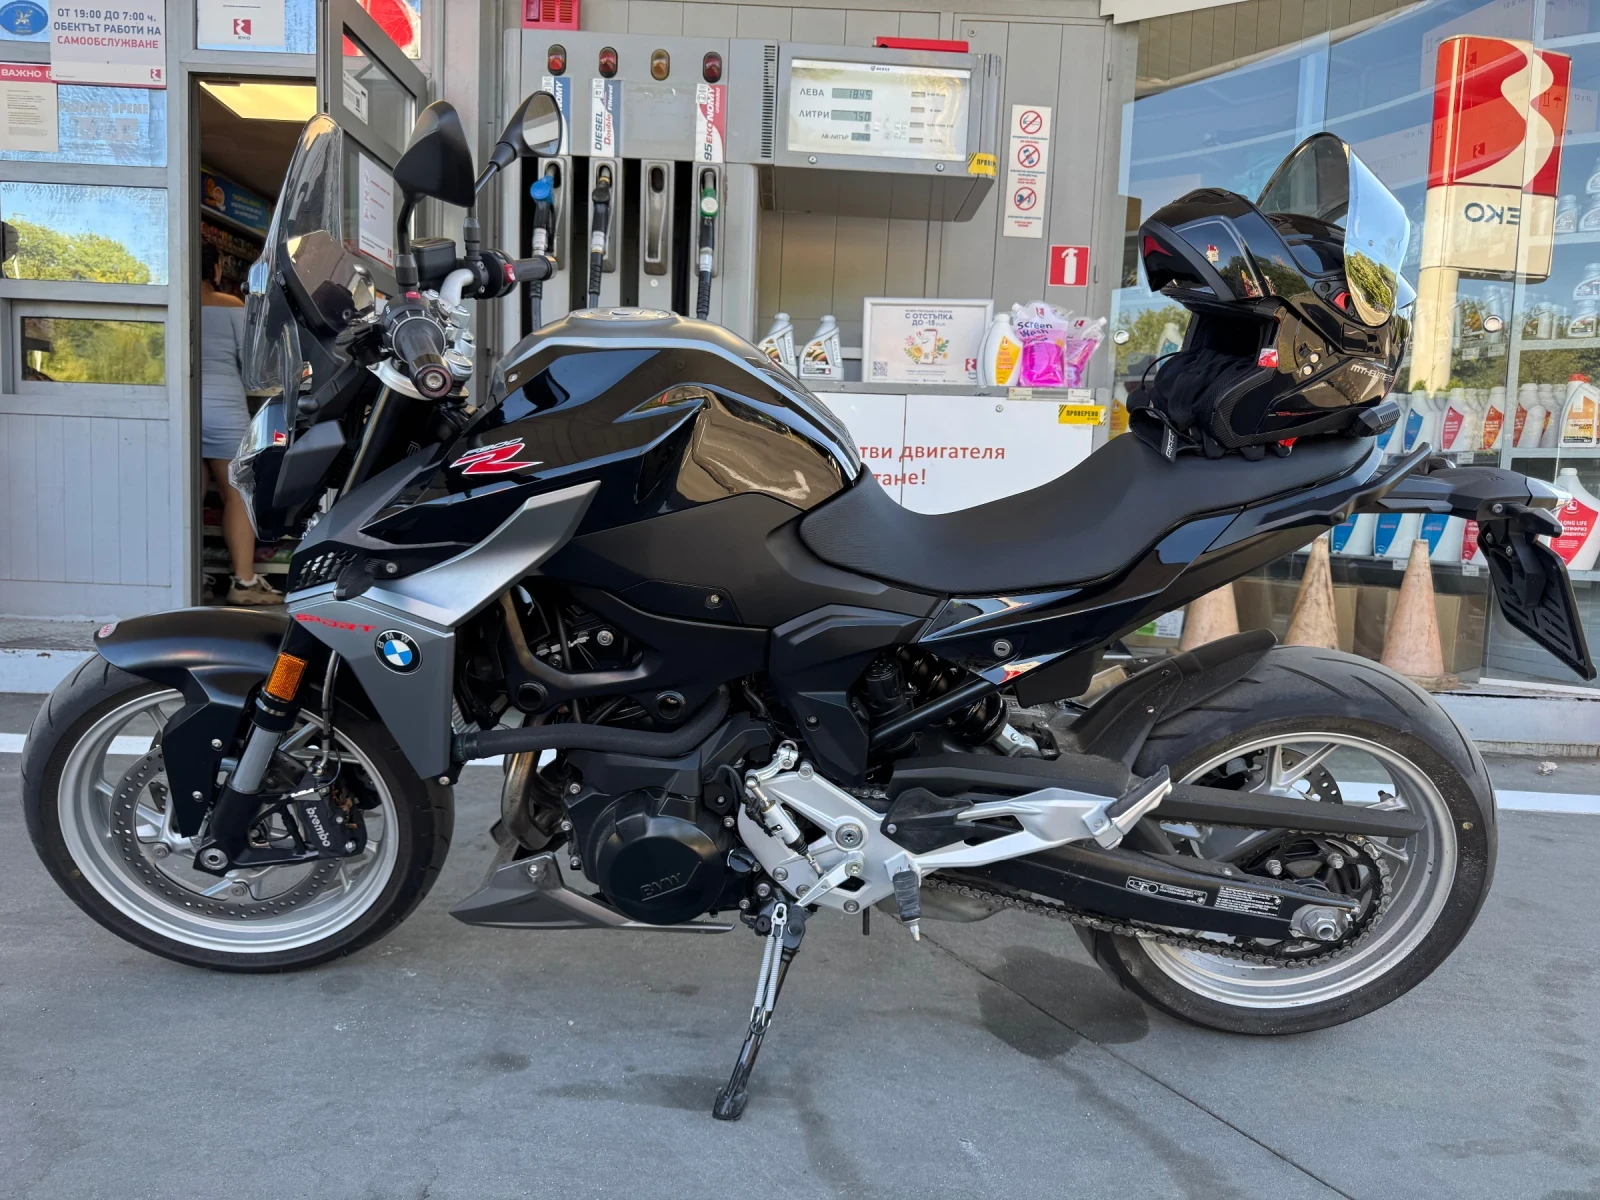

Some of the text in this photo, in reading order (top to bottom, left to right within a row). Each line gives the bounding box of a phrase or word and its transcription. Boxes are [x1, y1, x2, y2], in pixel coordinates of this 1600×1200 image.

[57, 8, 71, 18] ОТ
[74, 9, 101, 19] 19:00
[104, 11, 120, 21] ДО
[123, 12, 145, 21] 7:00
[147, 14, 157, 22] ч.
[53, 21, 162, 36] ОБЕКТЪТ РАБОТИ НА
[57, 35, 159, 49] САМООБСЛУЖВАНЕ
[1, 69, 42, 78] ВАЖНО
[799, 88, 825, 97] ЛЕВА
[799, 110, 830, 119] ЛИТРИ
[594, 111, 603, 151] DIESEL
[603, 114, 613, 146] Double
[976, 158, 996, 167] ПРОВЕР
[1017, 321, 1053, 330] Screen
[1020, 329, 1049, 337] Wash
[860, 446, 1005, 463] тви двигателя
[874, 468, 926, 486] тане!
[296, 613, 377, 633] SPORT
[376, 632, 411, 649] BMW
[305, 806, 331, 847] brembo
